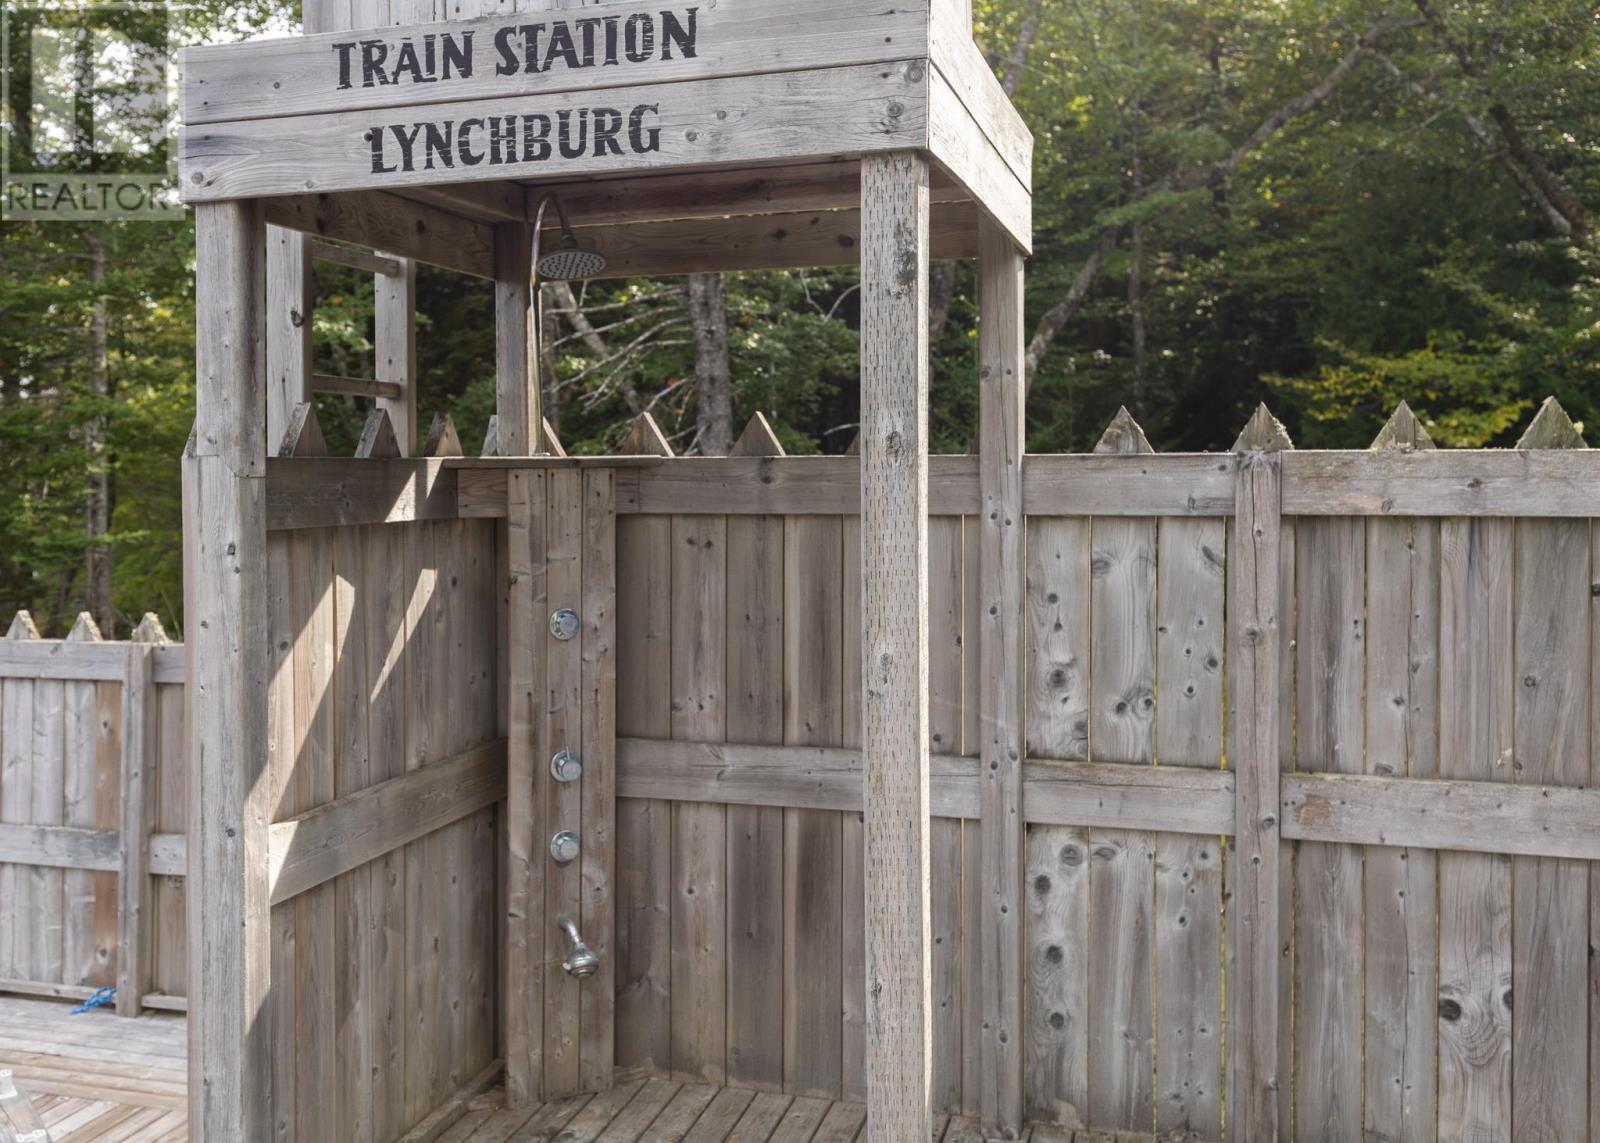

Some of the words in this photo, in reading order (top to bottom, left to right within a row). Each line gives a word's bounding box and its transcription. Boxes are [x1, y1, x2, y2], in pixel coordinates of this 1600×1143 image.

[332, 31, 475, 90] TRAIN
[494, 8, 699, 76] STATION
[370, 103, 661, 173] LYNCHBURG
